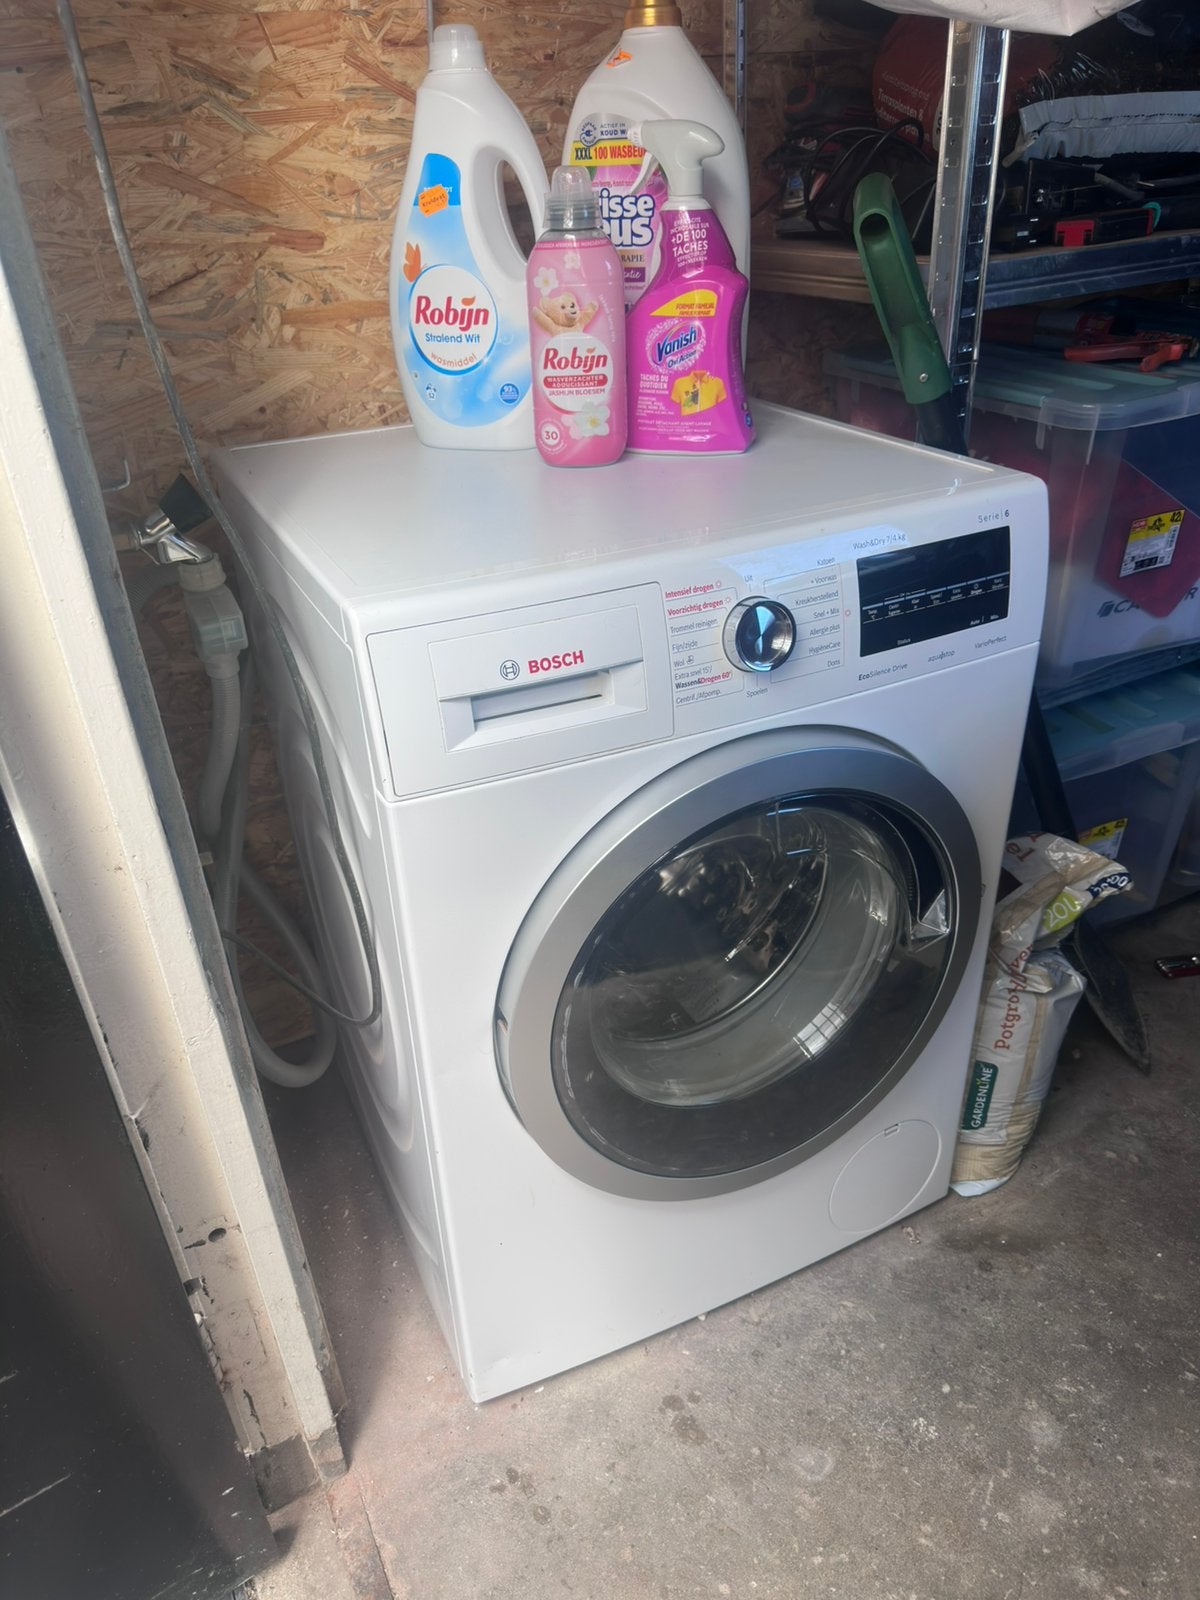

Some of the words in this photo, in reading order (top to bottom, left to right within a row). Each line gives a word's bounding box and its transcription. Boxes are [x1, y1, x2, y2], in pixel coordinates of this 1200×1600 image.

[574, 147, 593, 160] XXXL
[593, 146, 608, 160] 100
[599, 187, 657, 219] isse
[691, 229, 707, 242] 100
[672, 240, 709, 258] TACHES
[621, 254, 645, 263] RAPIE
[414, 295, 490, 333] Robijn
[425, 333, 463, 344] Stralend
[464, 333, 481, 344] Wit
[657, 326, 697, 362] Vanish
[429, 352, 478, 369] wasmiddel
[542, 346, 609, 374] Robijn
[547, 374, 604, 383] WASVERZACHTER
[544, 430, 559, 441] 30
[978, 513, 1000, 524] Serie
[1004, 509, 1010, 518] 6
[852, 537, 886, 550] Wash&Dry
[665, 586, 693, 600] Intensief
[692, 583, 715, 595] drogen
[667, 602, 703, 617] Voorzichtig
[702, 599, 724, 611] drogen
[670, 622, 695, 634] Trommel
[695, 618, 718, 628] reinigen
[829, 623, 841, 632] plus
[974, 635, 1007, 649] VarioPerfect
[527, 649, 585, 674] BOSCH
[673, 658, 685, 668] Wol
[827, 659, 841, 668] Dons
[674, 671, 691, 682] Extra
[690, 669, 703, 678] snel
[858, 667, 892, 682] EcoSilence
[892, 662, 908, 673] Drive
[745, 686, 769, 699] Spoelen
[970, 1065, 995, 1129] GARDENLINE
